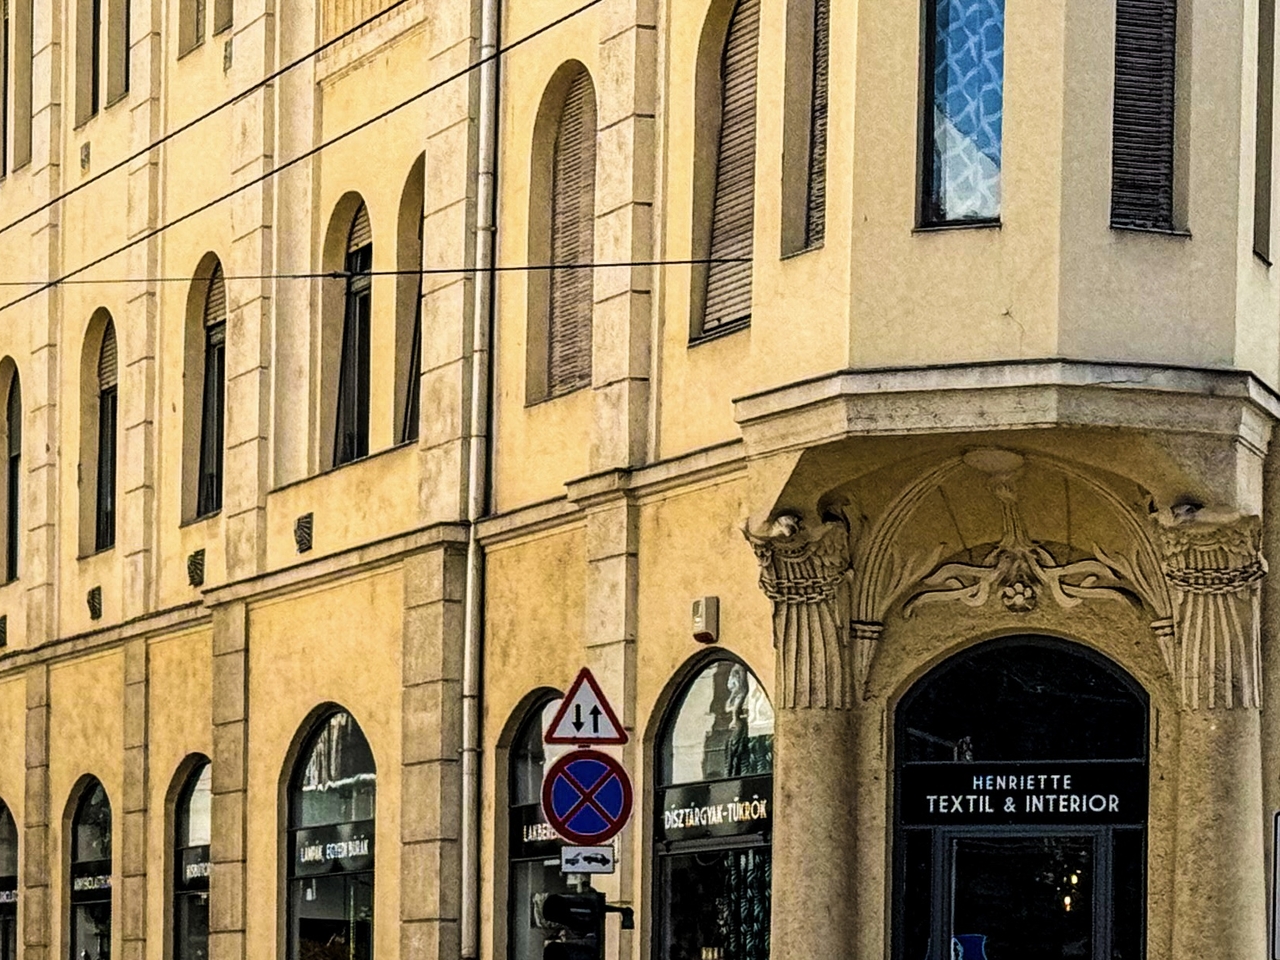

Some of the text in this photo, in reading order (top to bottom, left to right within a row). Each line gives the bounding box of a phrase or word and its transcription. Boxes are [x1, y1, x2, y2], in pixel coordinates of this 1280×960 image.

[972, 775, 1072, 790] HENRIETTE
[926, 794, 1119, 813] TEXTIL & INTERIOR
